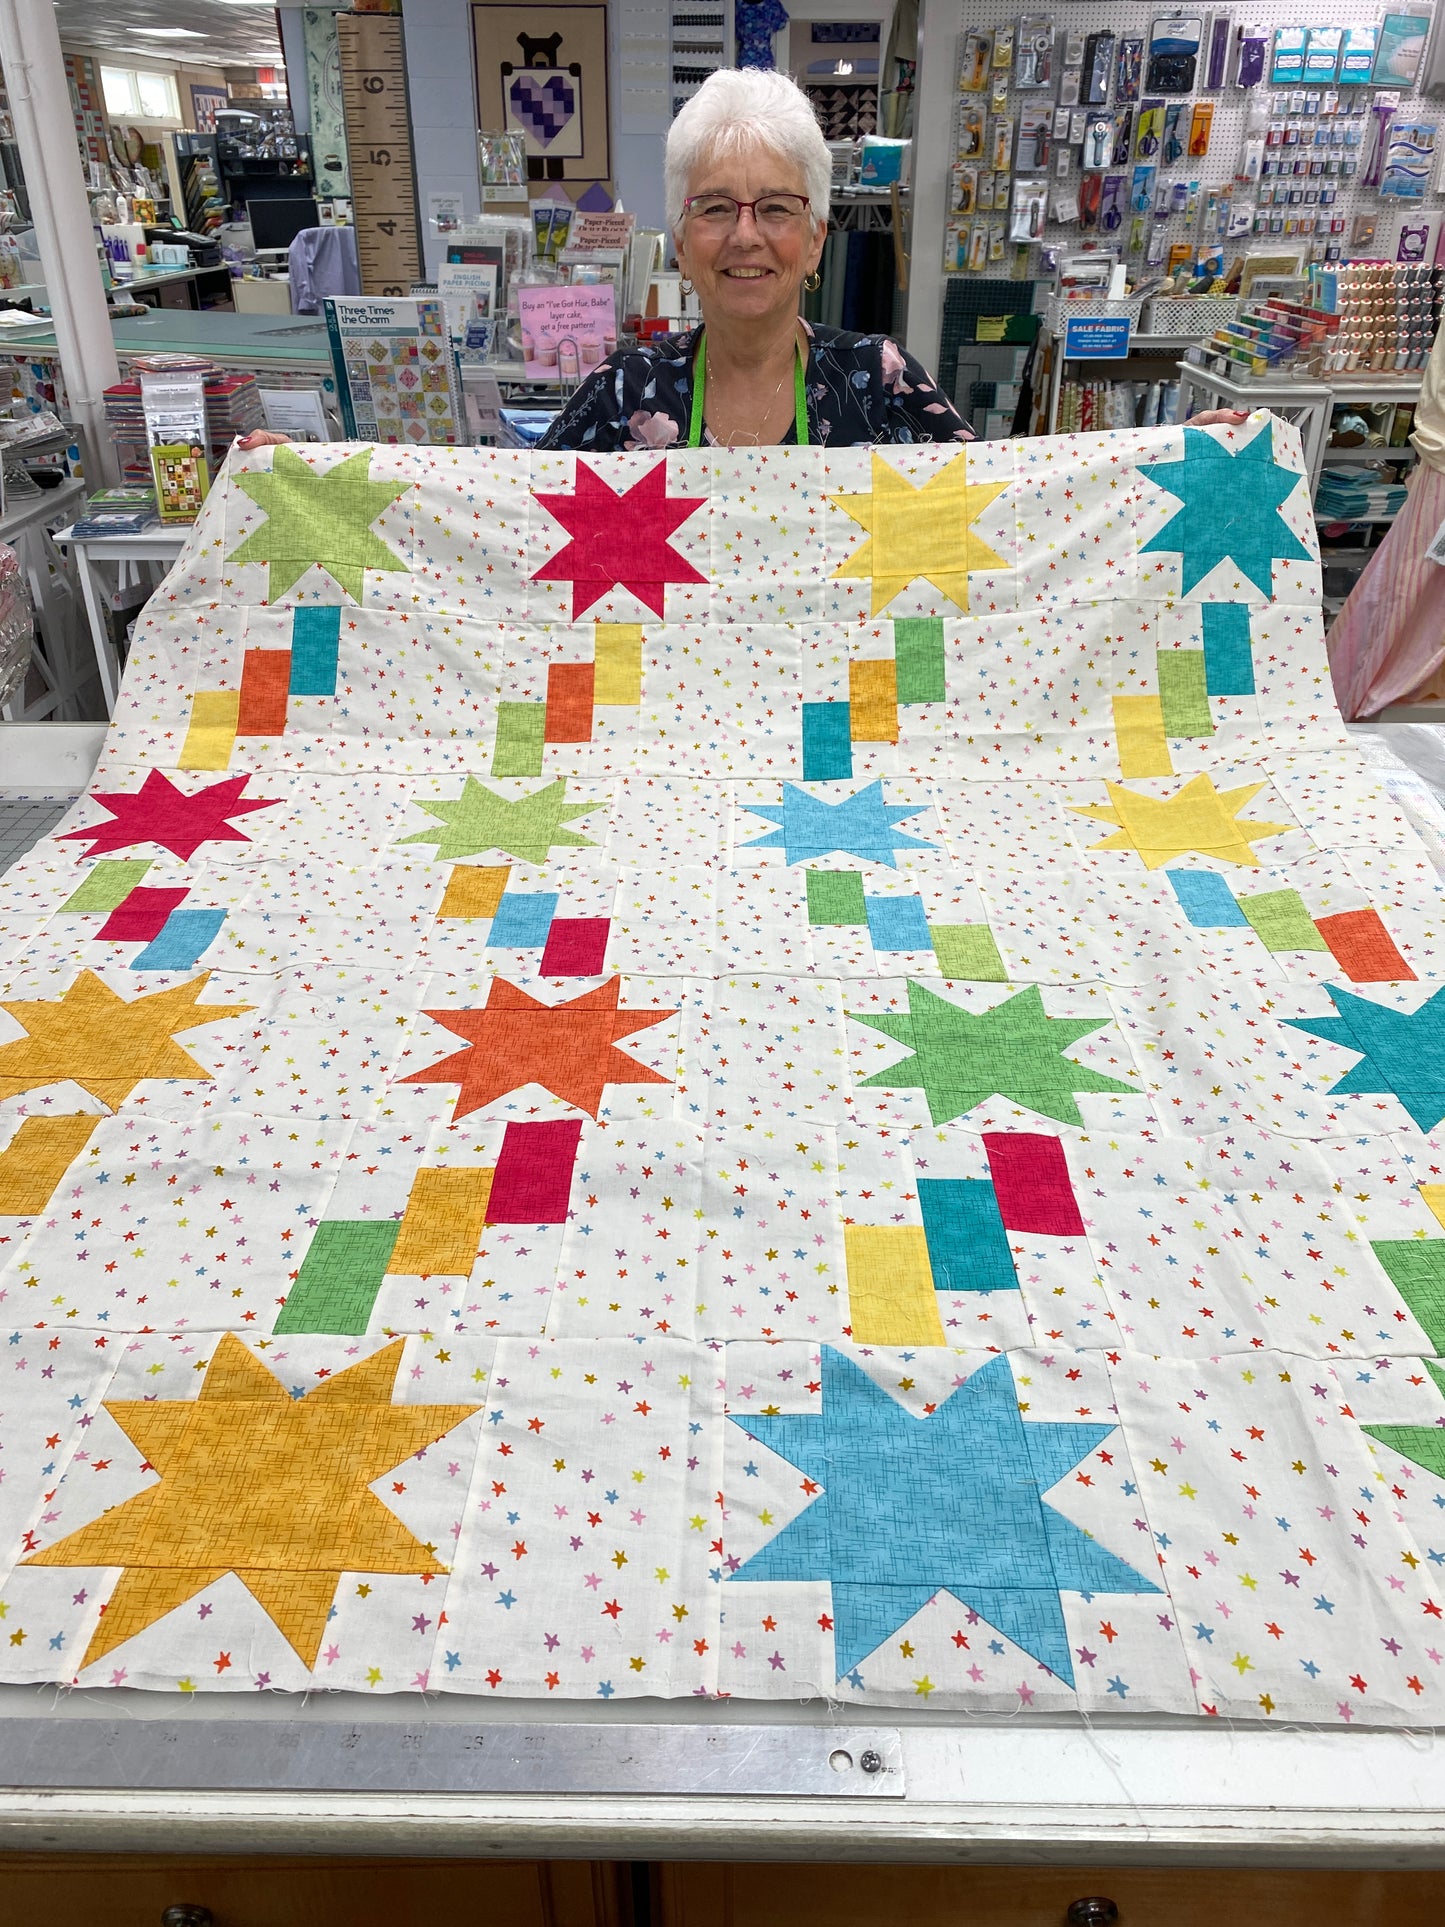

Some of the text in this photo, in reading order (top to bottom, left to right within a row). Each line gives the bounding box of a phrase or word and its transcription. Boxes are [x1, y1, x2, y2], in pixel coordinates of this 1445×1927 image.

[363, 76, 384, 94] 6
[370, 150, 391, 166] 5
[377, 219, 397, 236] 4
[338, 305, 395, 315] Three Times
[522, 301, 535, 311] Buy
[561, 299, 573, 307] Got
[575, 300, 590, 308] Hue,
[341, 314, 390, 324] the Charm
[550, 311, 582, 320] layer cake,
[541, 324, 550, 332] get
[557, 322, 570, 332] free
[571, 321, 596, 332] pattern!
